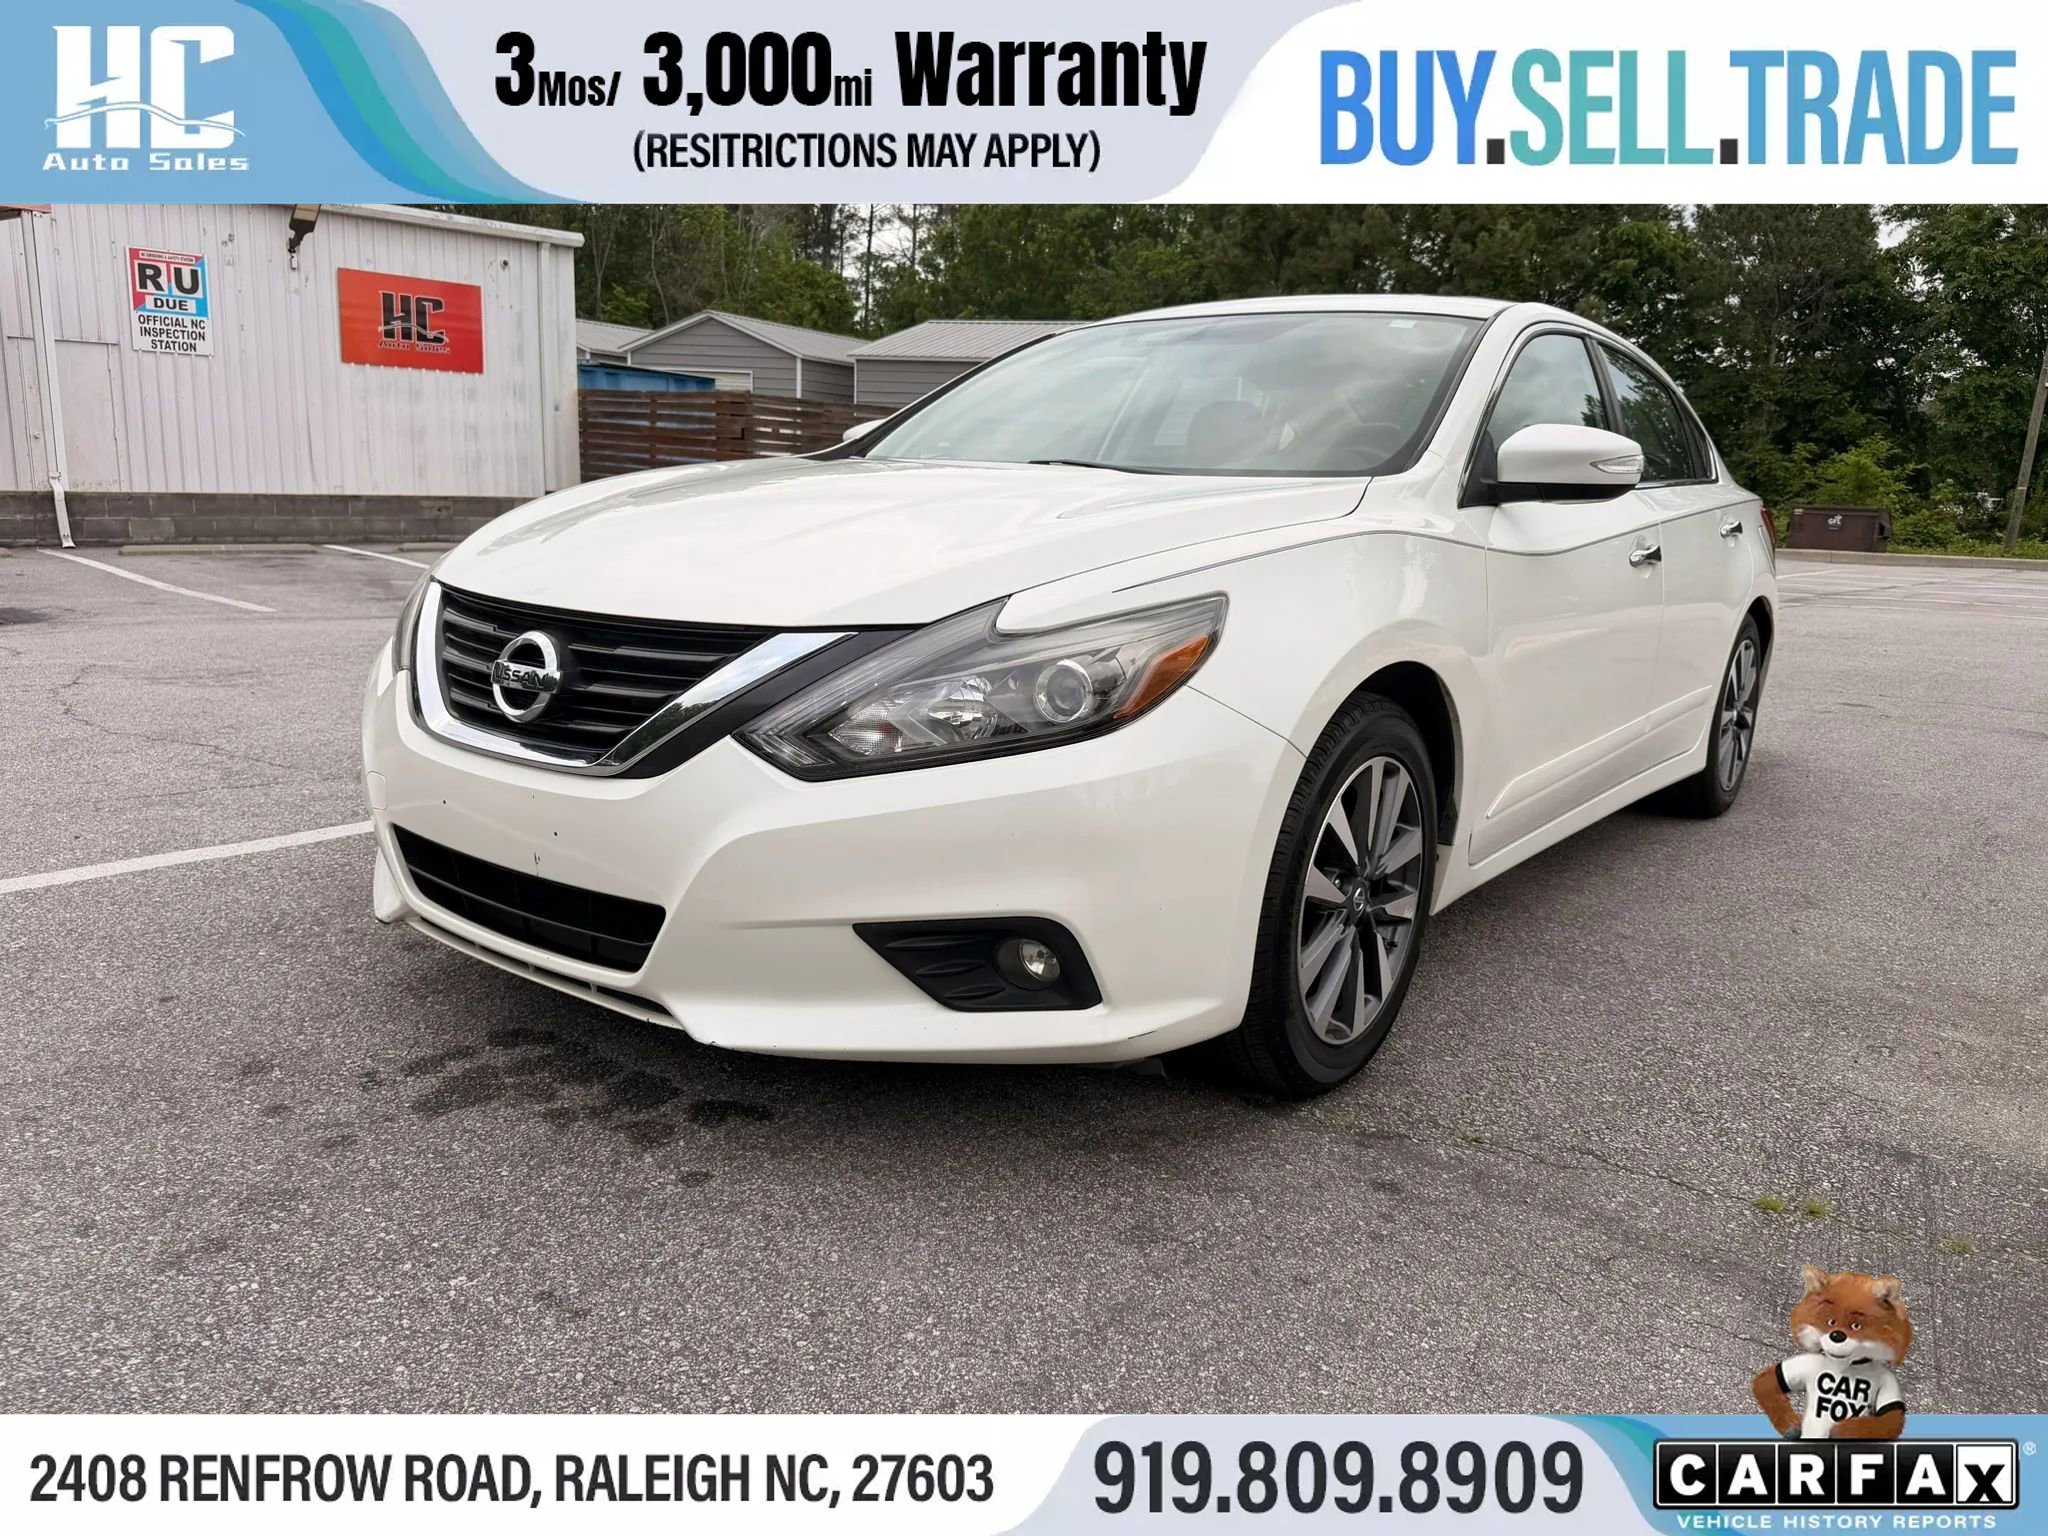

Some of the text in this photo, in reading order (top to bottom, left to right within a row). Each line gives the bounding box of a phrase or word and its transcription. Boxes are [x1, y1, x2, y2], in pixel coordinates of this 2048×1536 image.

[137, 262, 200, 295] R U
[153, 297, 189, 311] DUE
[138, 314, 206, 330] OFFICIAL NC
[380, 289, 445, 345] HC
[140, 326, 206, 342] INSPECTION
[151, 339, 197, 352] STATION
